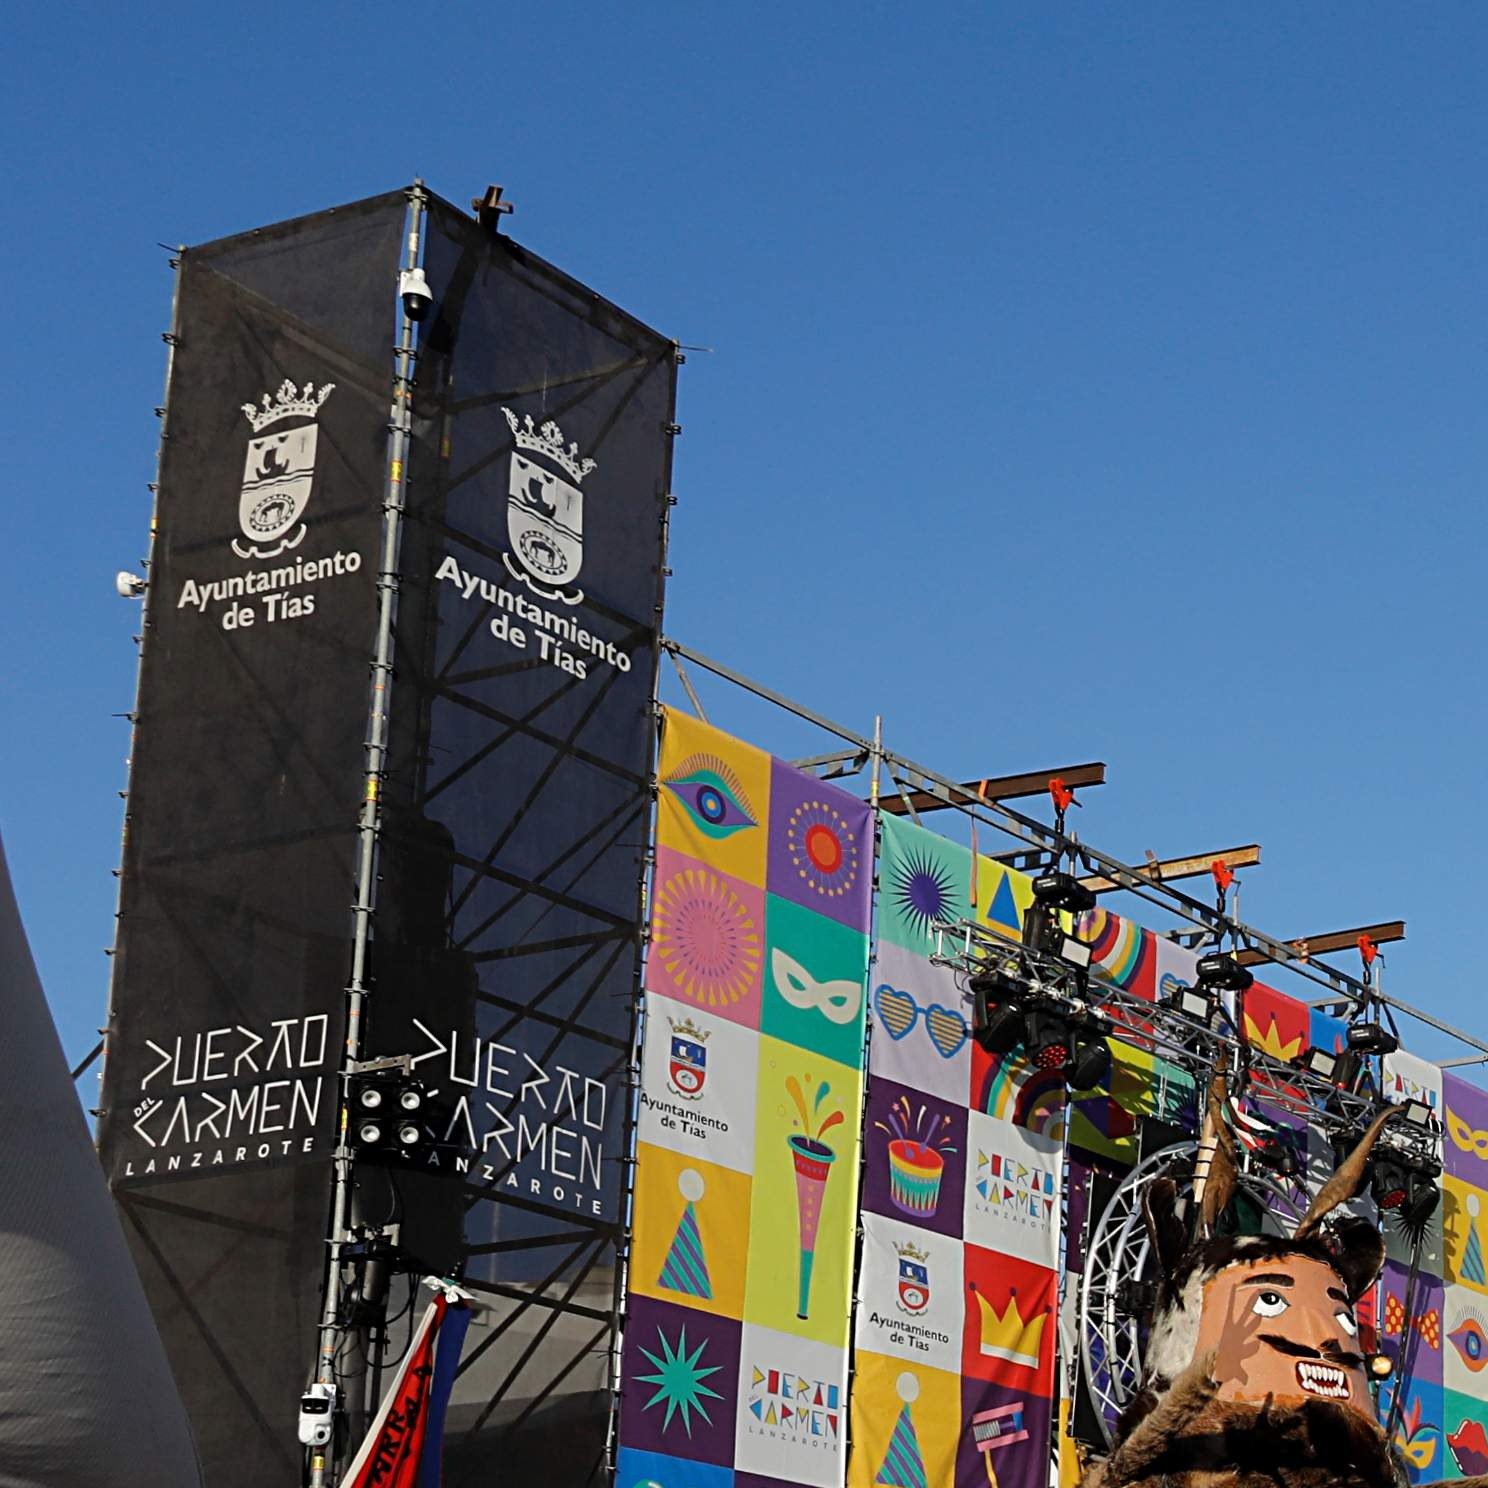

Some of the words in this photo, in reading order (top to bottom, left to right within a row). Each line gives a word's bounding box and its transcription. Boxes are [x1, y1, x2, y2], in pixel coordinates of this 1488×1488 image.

[177, 550, 361, 612] Ayuntamiento
[222, 602, 254, 630] de
[263, 592, 314, 622] Tías
[435, 556, 631, 673] Ayuntamiento
[491, 615, 526, 648] de
[535, 629, 586, 680] Tías
[141, 1014, 328, 1090] PUERTO
[409, 1018, 606, 1131] PUERTO
[133, 1097, 155, 1117] DEL
[133, 1076, 322, 1147] CARMEN
[640, 1093, 728, 1132] Ayuntamiento
[661, 1115, 676, 1129] de
[125, 1137, 313, 1176] LANZAROTE
[427, 1150, 602, 1215] ANZAROTE
[870, 1312, 949, 1343] Ayuntamiento
[890, 1332, 904, 1344] de
[749, 1425, 838, 1452] LANZAROTE
